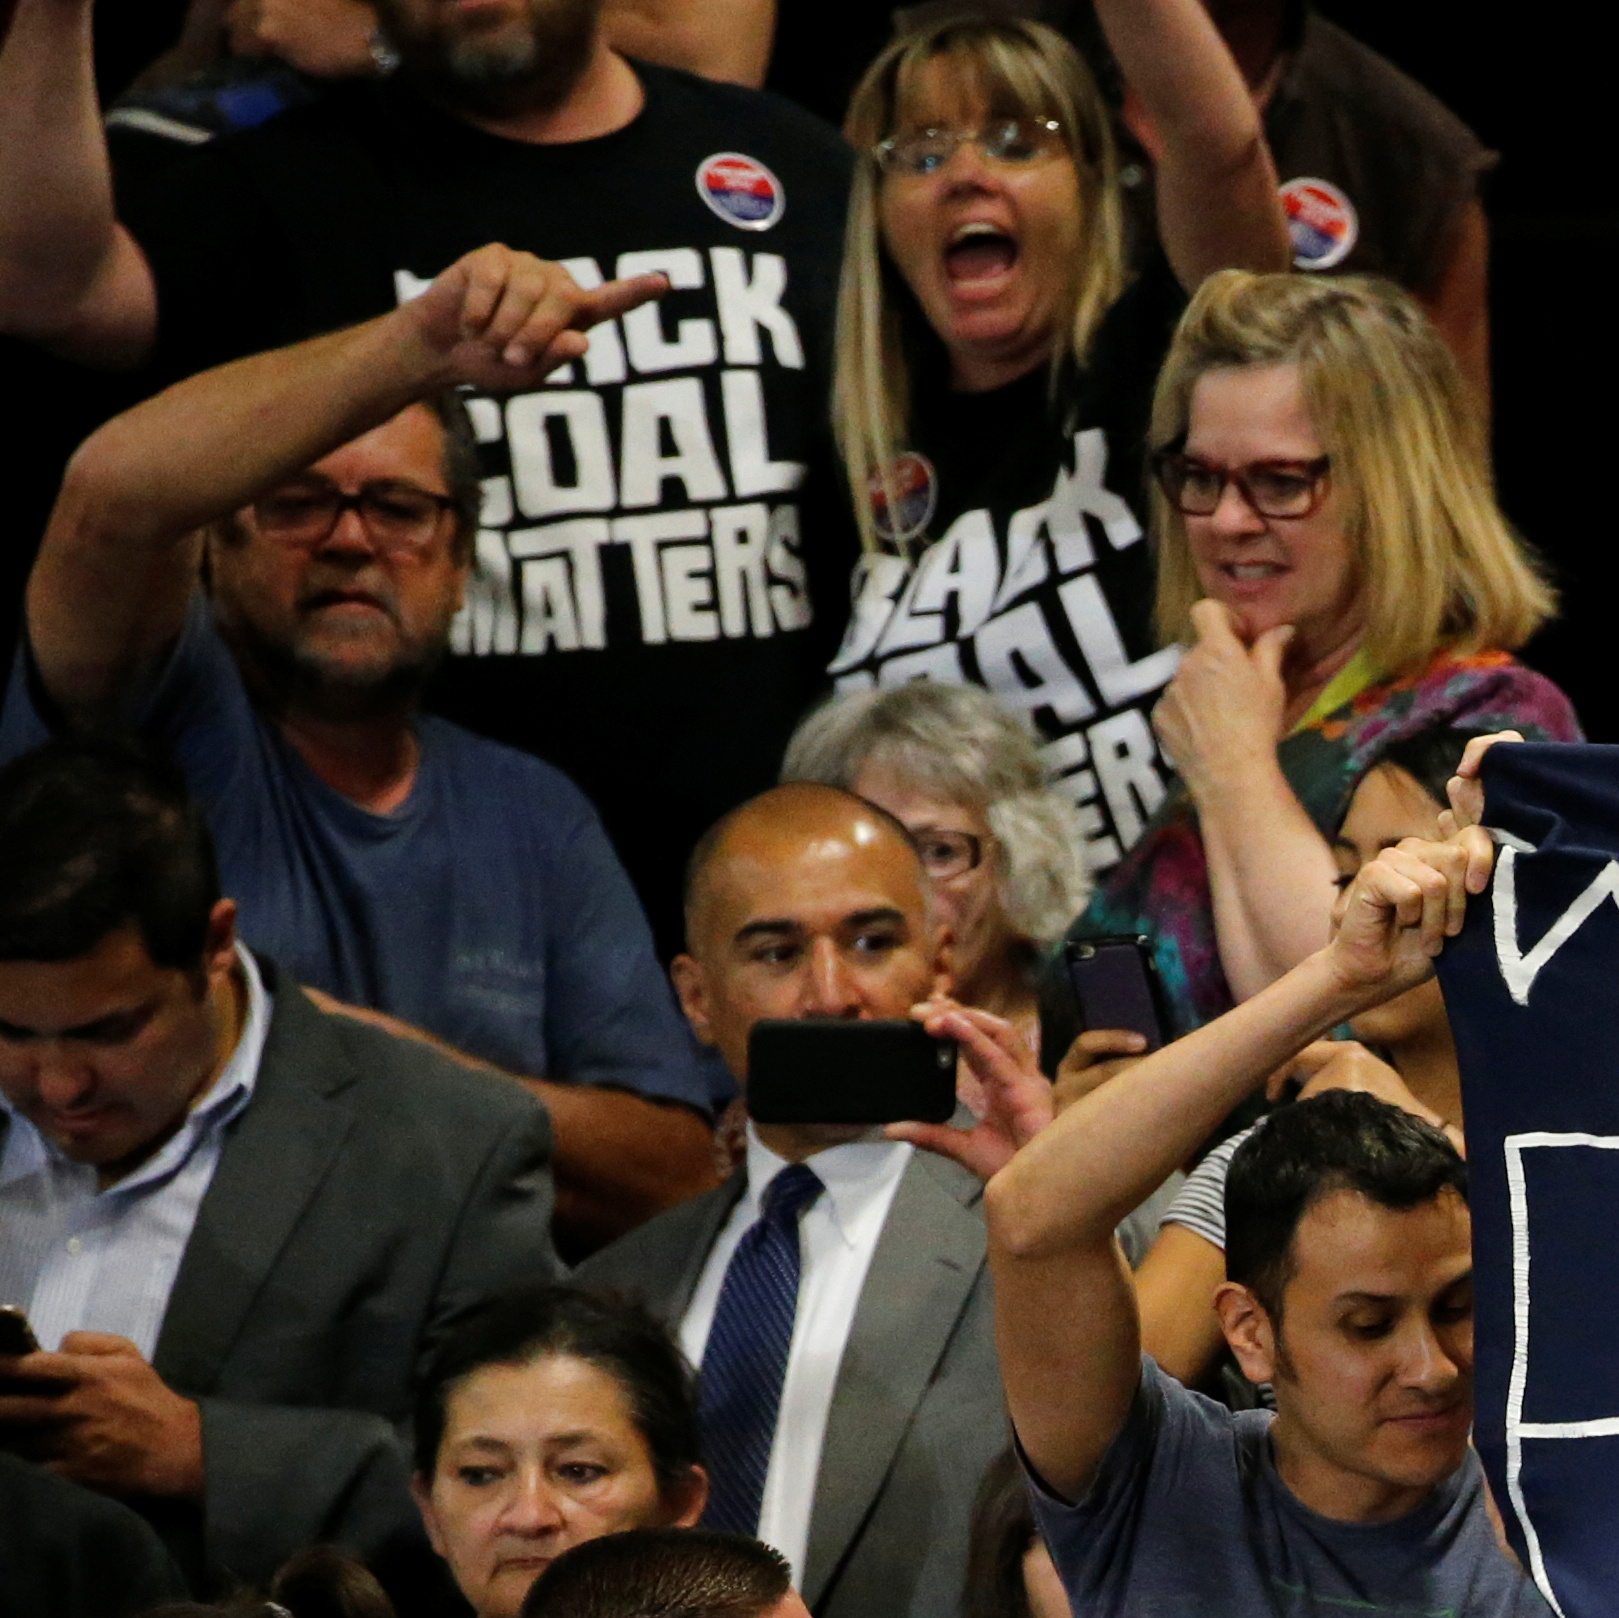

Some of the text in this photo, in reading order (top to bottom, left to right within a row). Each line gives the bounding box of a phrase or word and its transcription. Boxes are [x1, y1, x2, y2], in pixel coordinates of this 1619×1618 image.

[395, 246, 806, 387] ACK
[464, 367, 810, 529] COAL
[449, 502, 815, 657] MATTERS
